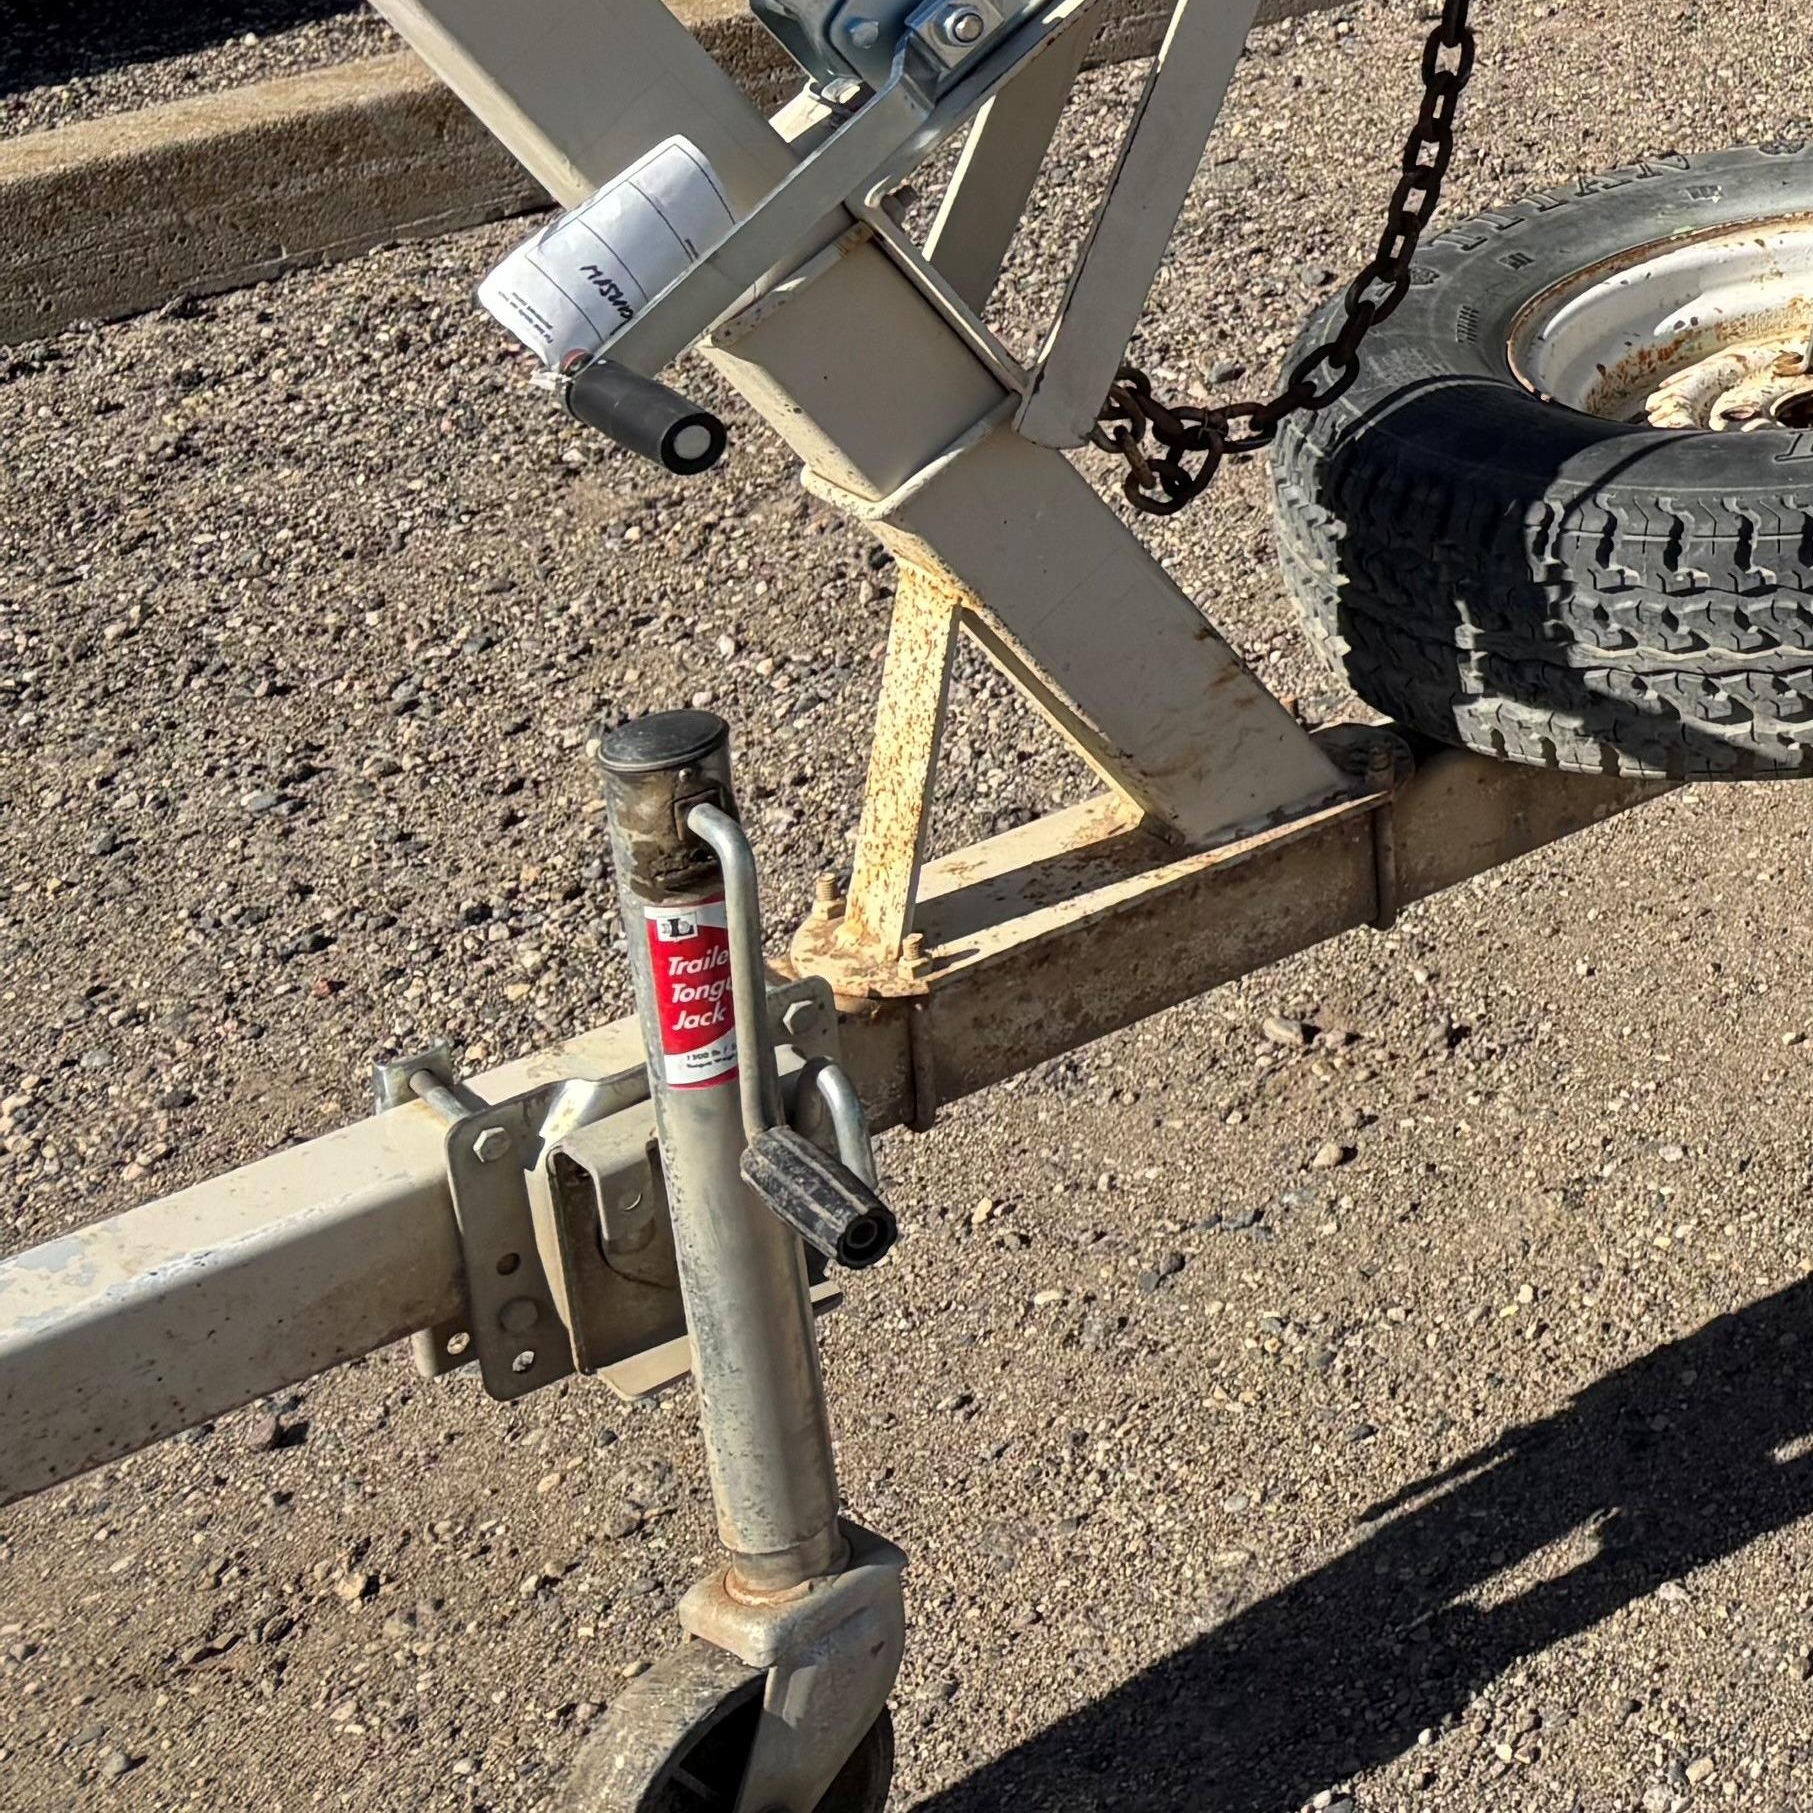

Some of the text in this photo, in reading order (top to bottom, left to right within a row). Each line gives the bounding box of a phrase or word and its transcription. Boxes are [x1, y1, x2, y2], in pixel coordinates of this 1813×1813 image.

[668, 944, 730, 977] Traile
[671, 978, 733, 1004] Tong
[671, 1001, 727, 1032] Jack
